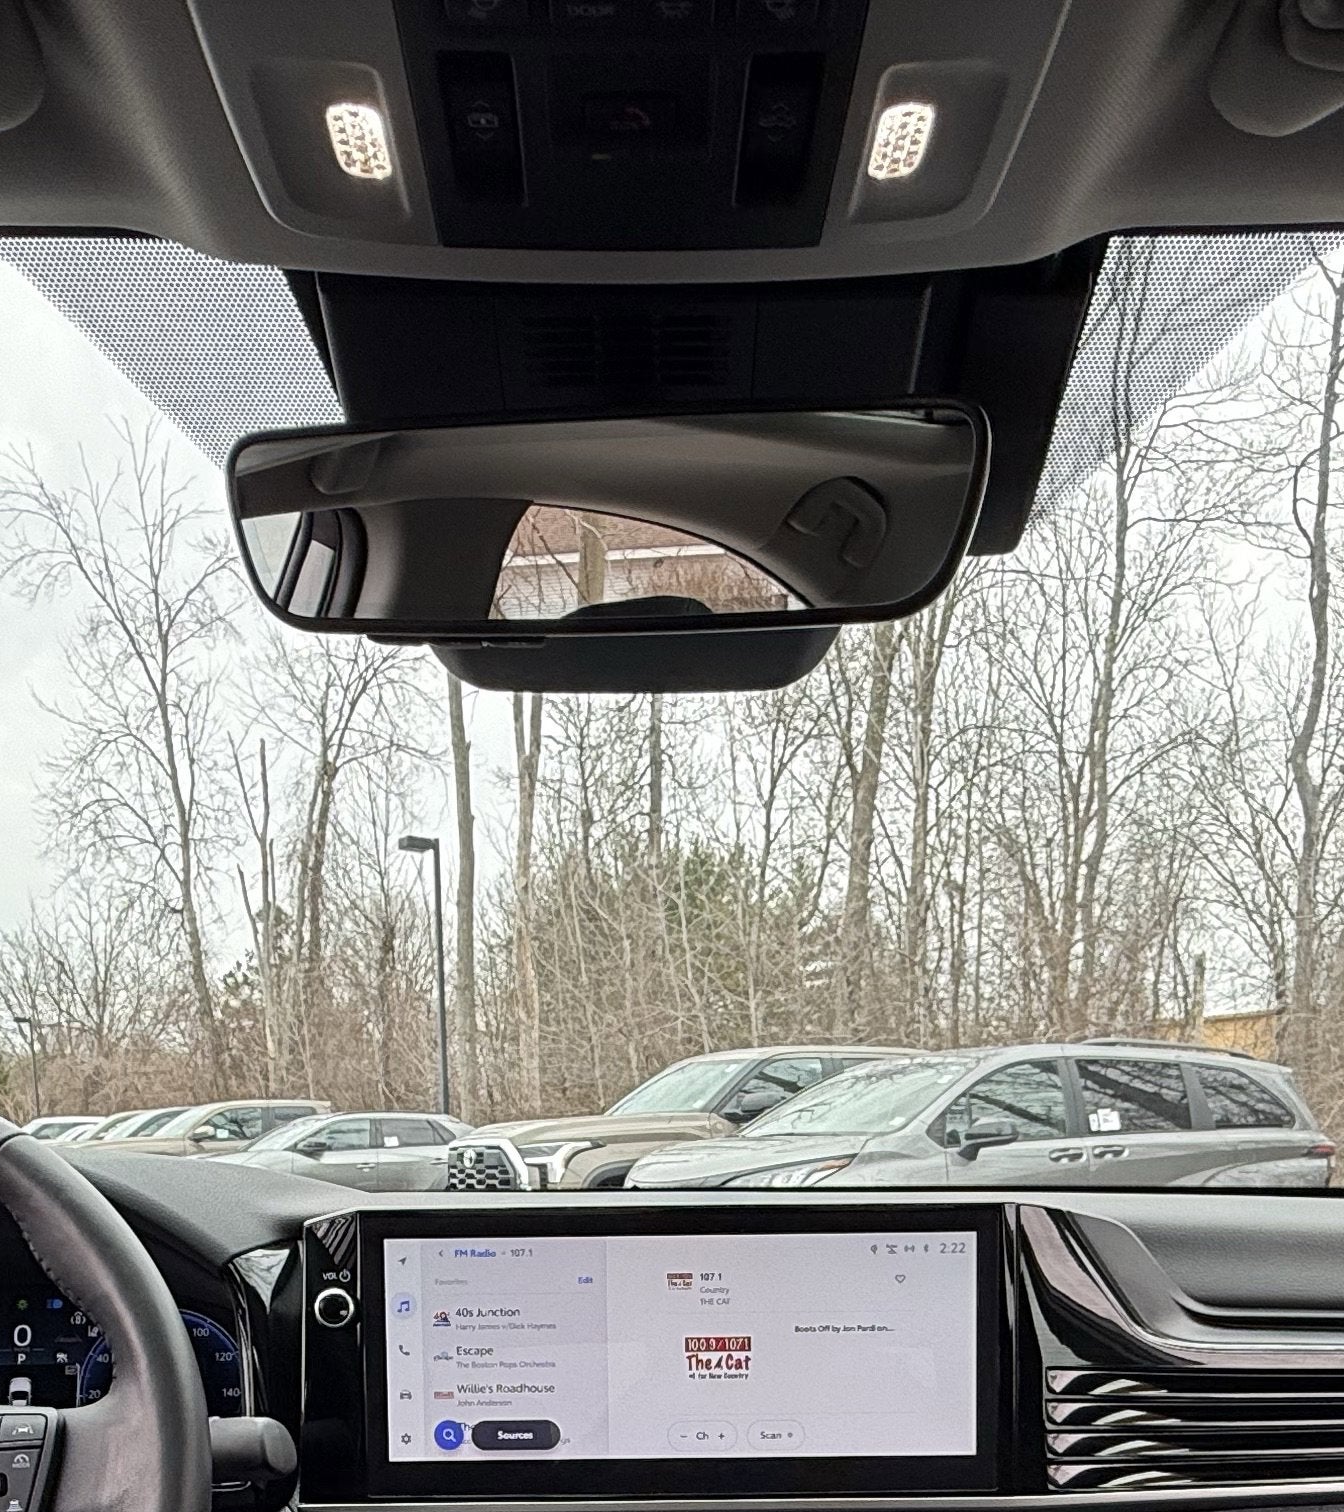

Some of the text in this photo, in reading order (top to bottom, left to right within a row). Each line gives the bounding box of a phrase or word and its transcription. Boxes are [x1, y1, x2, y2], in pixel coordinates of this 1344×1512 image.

[470, 1249, 496, 1258] Radio
[510, 1249, 533, 1257] 107.1
[323, 1272, 337, 1280] VOL
[578, 1276, 593, 1284] Edit
[699, 1286, 730, 1295] Country
[699, 1298, 714, 1306] THE
[456, 1308, 520, 1317] 40s Junction
[193, 1328, 209, 1337] 100
[794, 1325, 817, 1333] Boots
[831, 1325, 841, 1333] by
[13, 1324, 32, 1347] 0
[456, 1346, 494, 1357] Escape
[17, 1353, 27, 1365] P
[96, 1353, 110, 1363] 40
[215, 1352, 232, 1361] 120
[472, 1361, 497, 1369] Boston
[686, 1353, 751, 1371] The Cat
[724, 1372, 749, 1380] Country
[222, 1388, 240, 1397] 140
[456, 1383, 555, 1394] Willie's Roadhouse
[88, 1389, 101, 1399] 20
[497, 1430, 534, 1440] Sources
[695, 1432, 709, 1440] Ch
[760, 1431, 782, 1440] Scan
